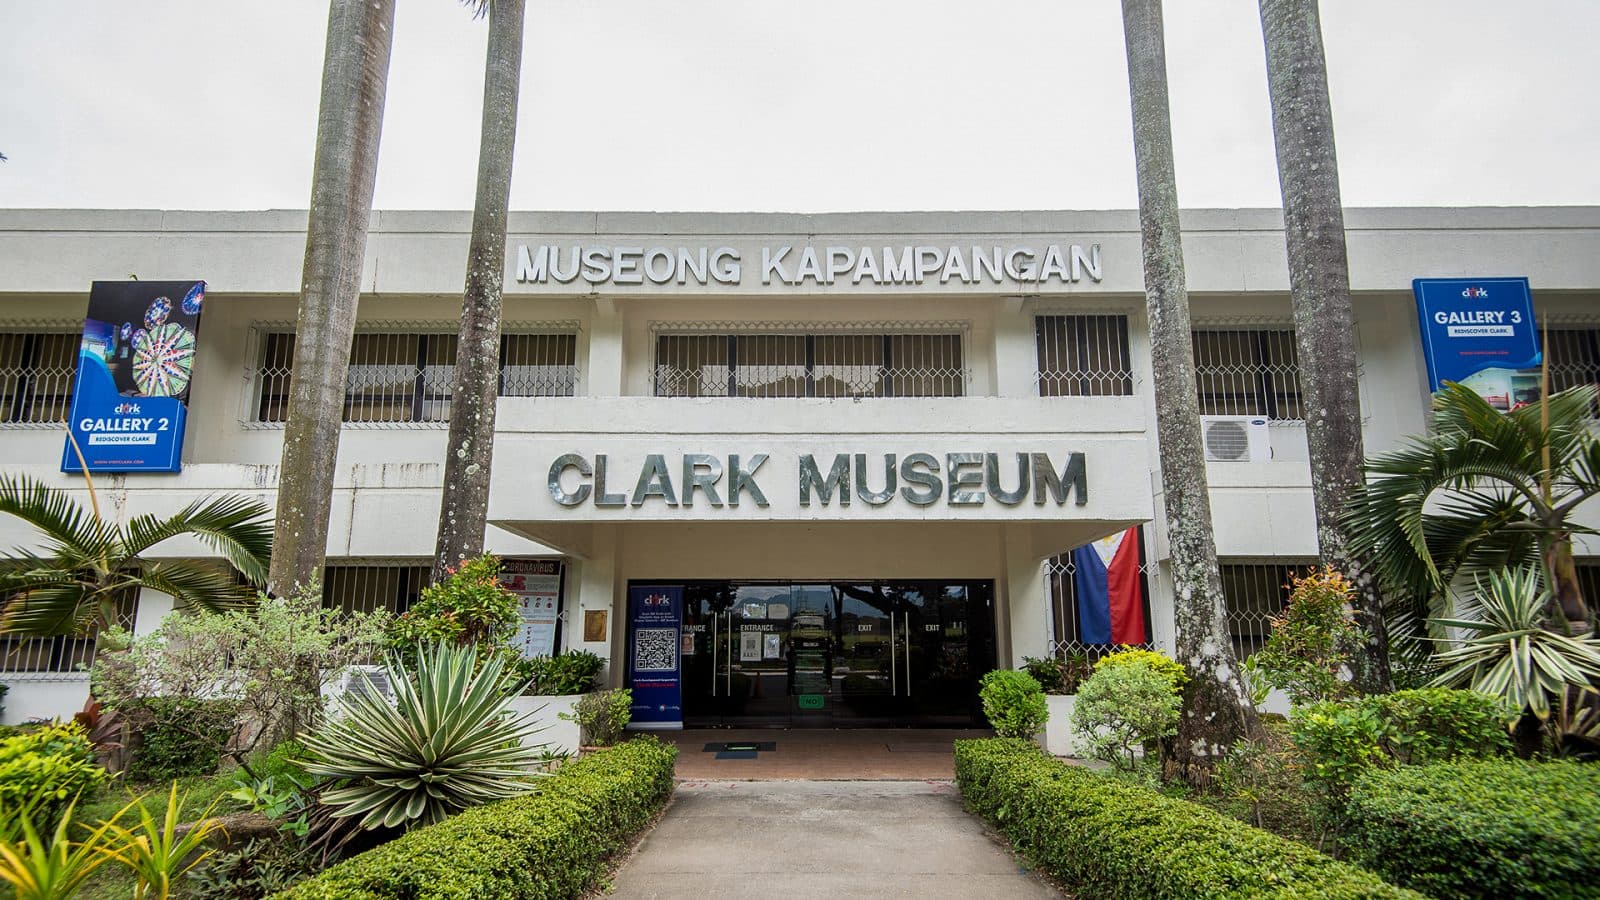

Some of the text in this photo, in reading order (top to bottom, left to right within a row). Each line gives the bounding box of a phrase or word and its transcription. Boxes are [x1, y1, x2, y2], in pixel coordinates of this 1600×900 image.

[516, 244, 1103, 285] MUSEONG KAPAMPANGAN
[1434, 310, 1522, 324] GALLERY 3
[80, 418, 169, 431] GALLERY 2
[547, 452, 1088, 507] CLARK MUSEUM
[740, 624, 774, 632] ENTRANCE
[858, 624, 873, 632] EXIT
[925, 624, 940, 632] EXIT
